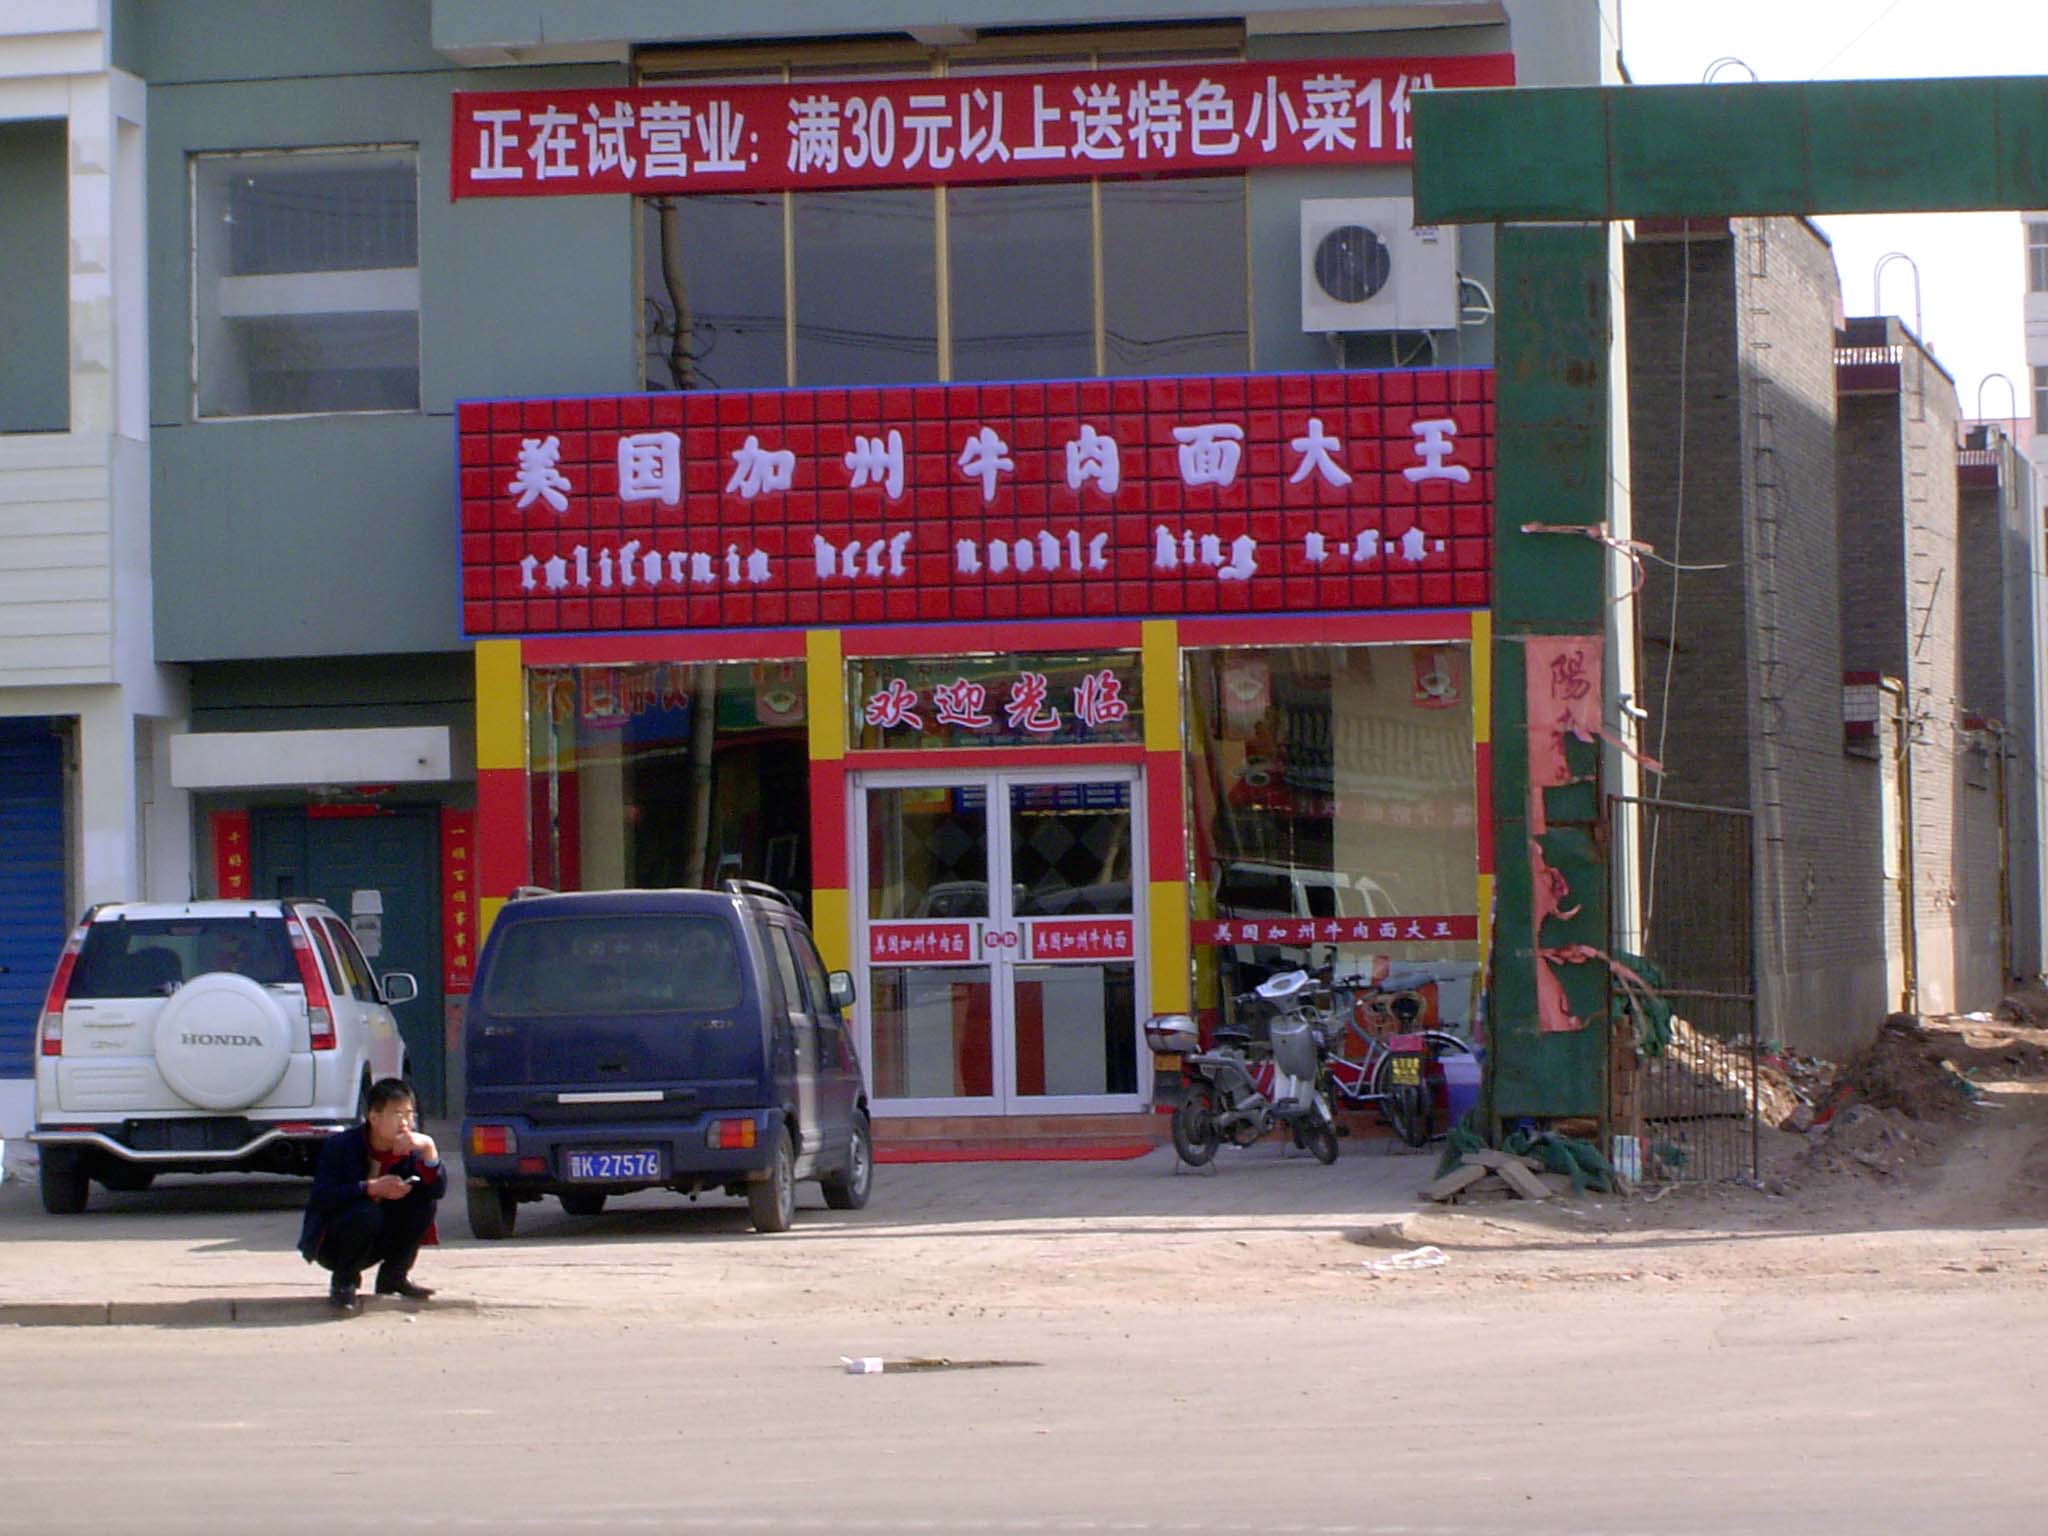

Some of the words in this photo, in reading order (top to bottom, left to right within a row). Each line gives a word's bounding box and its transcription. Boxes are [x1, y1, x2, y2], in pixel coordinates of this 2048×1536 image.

[508, 417, 1471, 512] 美国加州牛肉面大王
[812, 530, 912, 578] beef
[955, 528, 1109, 574] noodle
[1153, 524, 1258, 580] king
[865, 669, 1129, 731] 欢迎光临
[1213, 919, 1452, 942] 美国加州牛肉面大王
[180, 1033, 264, 1047] HONDA
